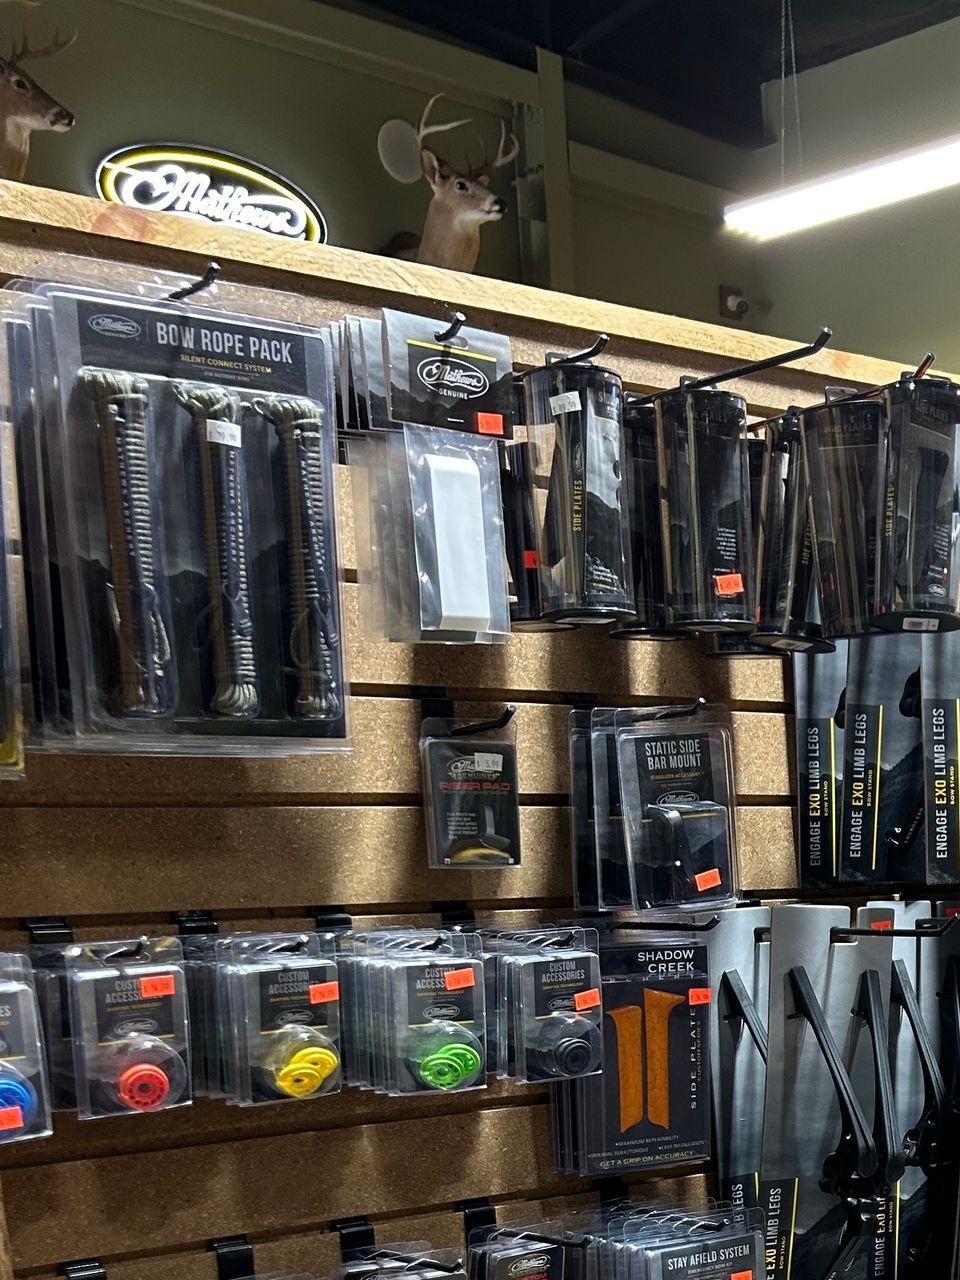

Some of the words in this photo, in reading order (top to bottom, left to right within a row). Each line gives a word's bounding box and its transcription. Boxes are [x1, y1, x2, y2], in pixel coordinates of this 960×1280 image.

[121, 164, 307, 236] Mathews
[156, 321, 195, 350] BOW
[201, 328, 244, 357] ROPE
[249, 336, 293, 364] PACK
[180, 354, 205, 365] SILENT
[206, 357, 243, 370] CONNECT
[244, 364, 272, 374] SYSTEM
[422, 363, 484, 391] Mathews
[438, 389, 469, 399] GENUINE
[573, 479, 582, 511] PLATES
[572, 511, 582, 533] SIDE
[885, 515, 893, 538] SIDE
[854, 713, 867, 744] LEGS
[932, 708, 945, 740] LEGS
[645, 740, 677, 756] STATIC
[679, 739, 701, 754] SIDE
[808, 727, 819, 757] LEGS
[647, 755, 667, 770] BAR
[669, 753, 702, 769] MOUNT
[853, 747, 866, 779] LIMB
[933, 743, 946, 776] LIMB
[808, 760, 820, 790] LIMB
[809, 793, 821, 817] EXO
[852, 782, 864, 806] EXO
[934, 779, 947, 805] EXO
[810, 820, 821, 867] ENGAGE
[850, 810, 863, 858] ENGAGE
[936, 808, 948, 859] ENGAGE
[549, 960, 576, 972] CUSTOM
[637, 949, 695, 962] SHADOW
[648, 961, 695, 973] CREEK
[278, 970, 310, 983] CUSTOM
[541, 969, 586, 984] ACCESSORIES
[600, 1161, 616, 1169] GET
[623, 1157, 641, 1165] GRIP
[655, 1150, 695, 1160] ACCURACY
[769, 1187, 782, 1217] LEGS
[766, 1218, 779, 1249] LIMB
[667, 1256, 690, 1271] STAY
[690, 1250, 717, 1267] AFIELD
[719, 1244, 750, 1260] SYSTEM
[766, 1249, 778, 1270] EXO
[874, 1236, 886, 1277] ENGAGE
